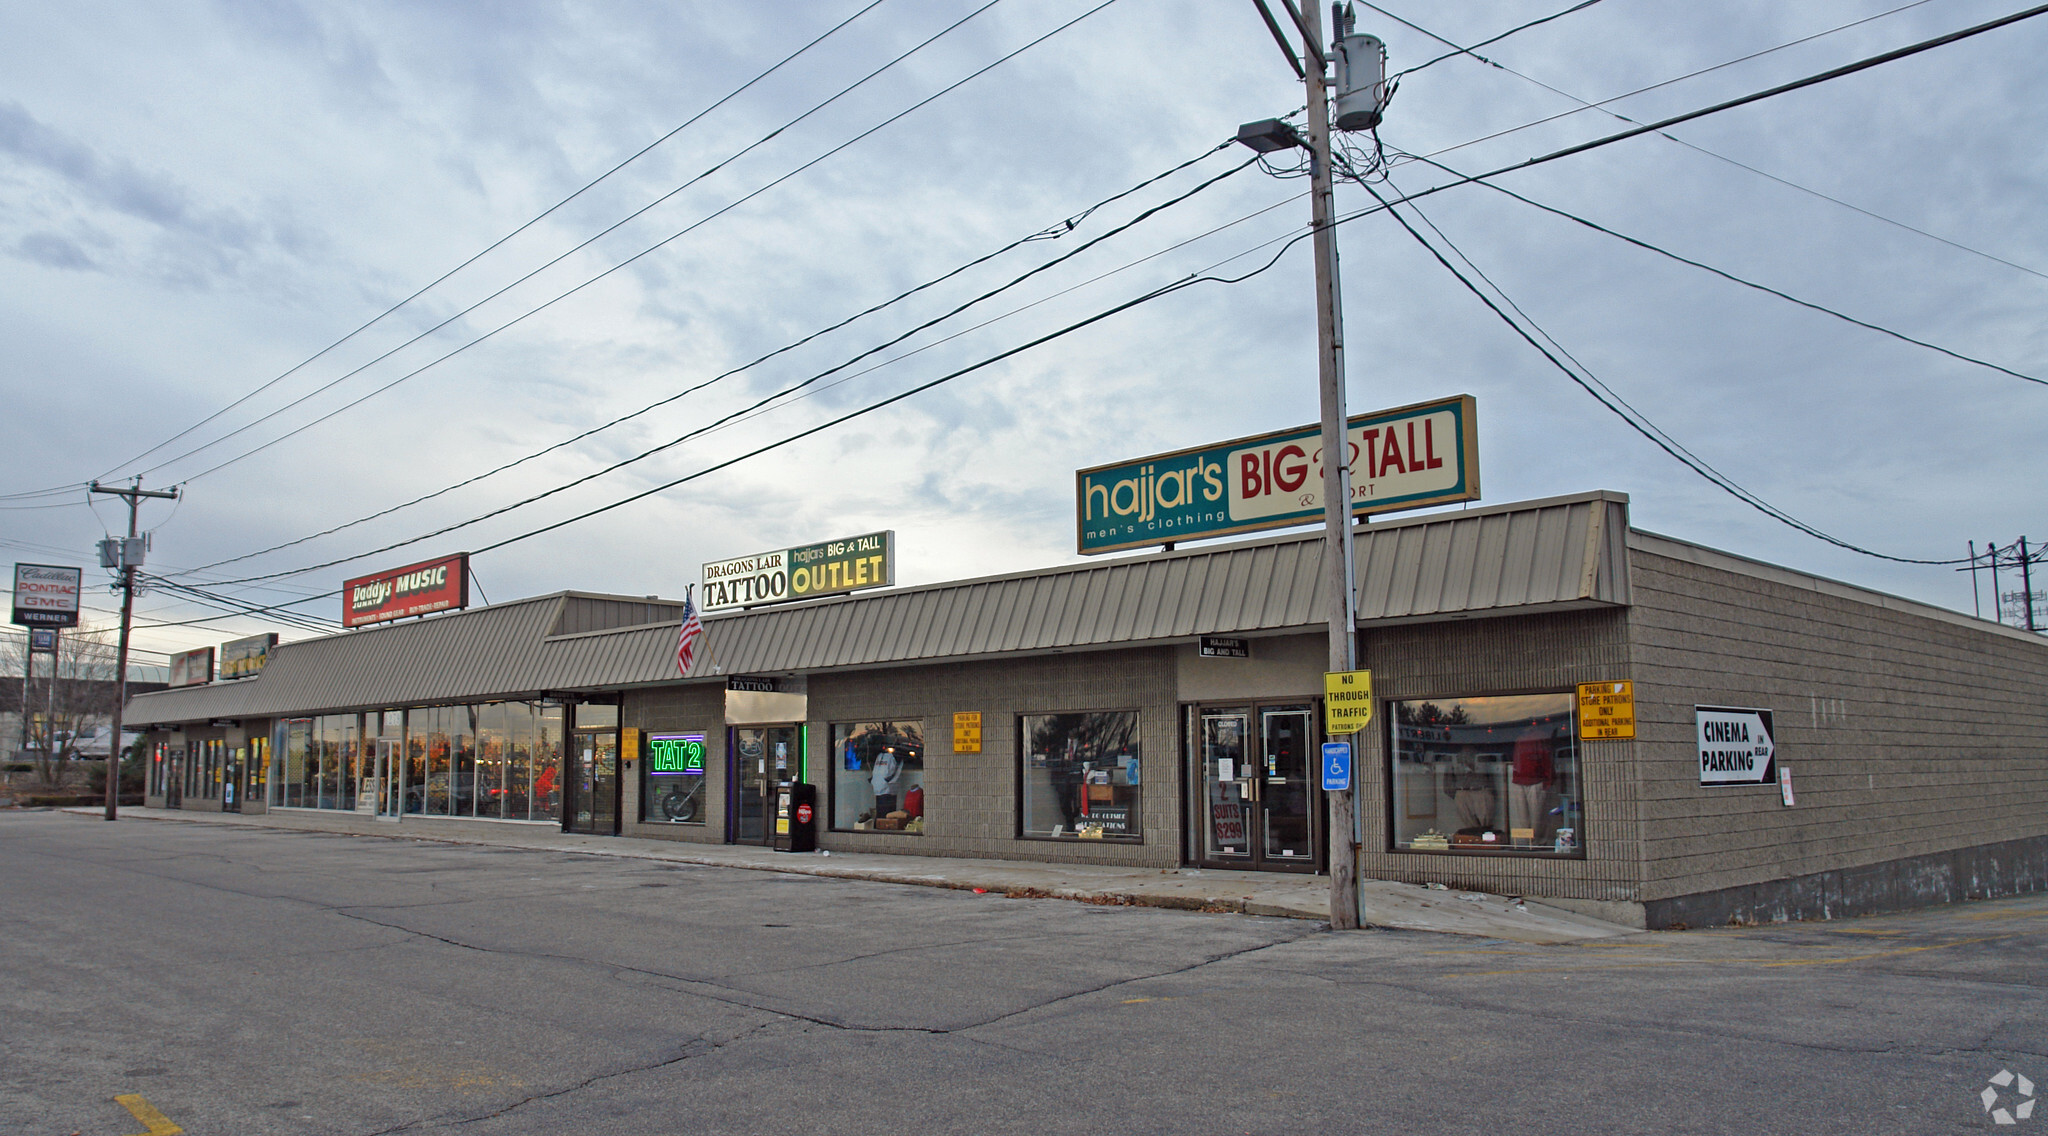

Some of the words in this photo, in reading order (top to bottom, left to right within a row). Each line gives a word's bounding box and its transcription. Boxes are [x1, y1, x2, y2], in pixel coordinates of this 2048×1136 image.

[1241, 444, 1308, 500] BIG
[1363, 418, 1443, 479] TALL
[1085, 456, 1223, 523] hajjar's
[1299, 493, 1315, 507] &
[1087, 524, 1134, 540] men's
[1147, 511, 1225, 531] clothing
[827, 542, 846, 557] BIG
[846, 541, 855, 553] &
[857, 535, 881, 552] TALL
[707, 559, 754, 580] DRAGONS
[756, 554, 782, 571] LAIR
[792, 554, 883, 593] OUTLET
[20, 567, 77, 582] Cadillac
[395, 565, 447, 593] MUSIC
[19, 582, 77, 595] PONTIAC
[703, 570, 787, 607] TATTOO
[24, 596, 69, 608] GMC
[23, 612, 69, 622] WERNER
[1203, 647, 1215, 655] BIG
[1216, 648, 1230, 656] AND
[1232, 648, 1246, 656] TALL
[731, 680, 773, 692] TATTOO
[1341, 674, 1354, 685] NO
[1328, 690, 1369, 702] THROUGH
[1584, 684, 1612, 695] PARKING
[1580, 695, 1601, 706] STORE
[1602, 694, 1632, 705] PATRONS
[1331, 707, 1368, 718] TRAFFIC
[1598, 706, 1614, 716] ONLY
[1331, 723, 1355, 731] PATRONS
[1611, 717, 1633, 726] PARKING
[1604, 727, 1618, 736] REAR
[1704, 721, 1750, 743] CINEMA
[1757, 735, 1764, 744] IN
[651, 740, 687, 771] TAT
[687, 742, 702, 769] 2
[1754, 746, 1769, 757] REAR
[1702, 750, 1754, 772] PARKING
[1326, 778, 1347, 786] PARKING
[1219, 781, 1229, 800] 2
[1213, 803, 1240, 820] SUITS
[1216, 821, 1243, 841] $299
